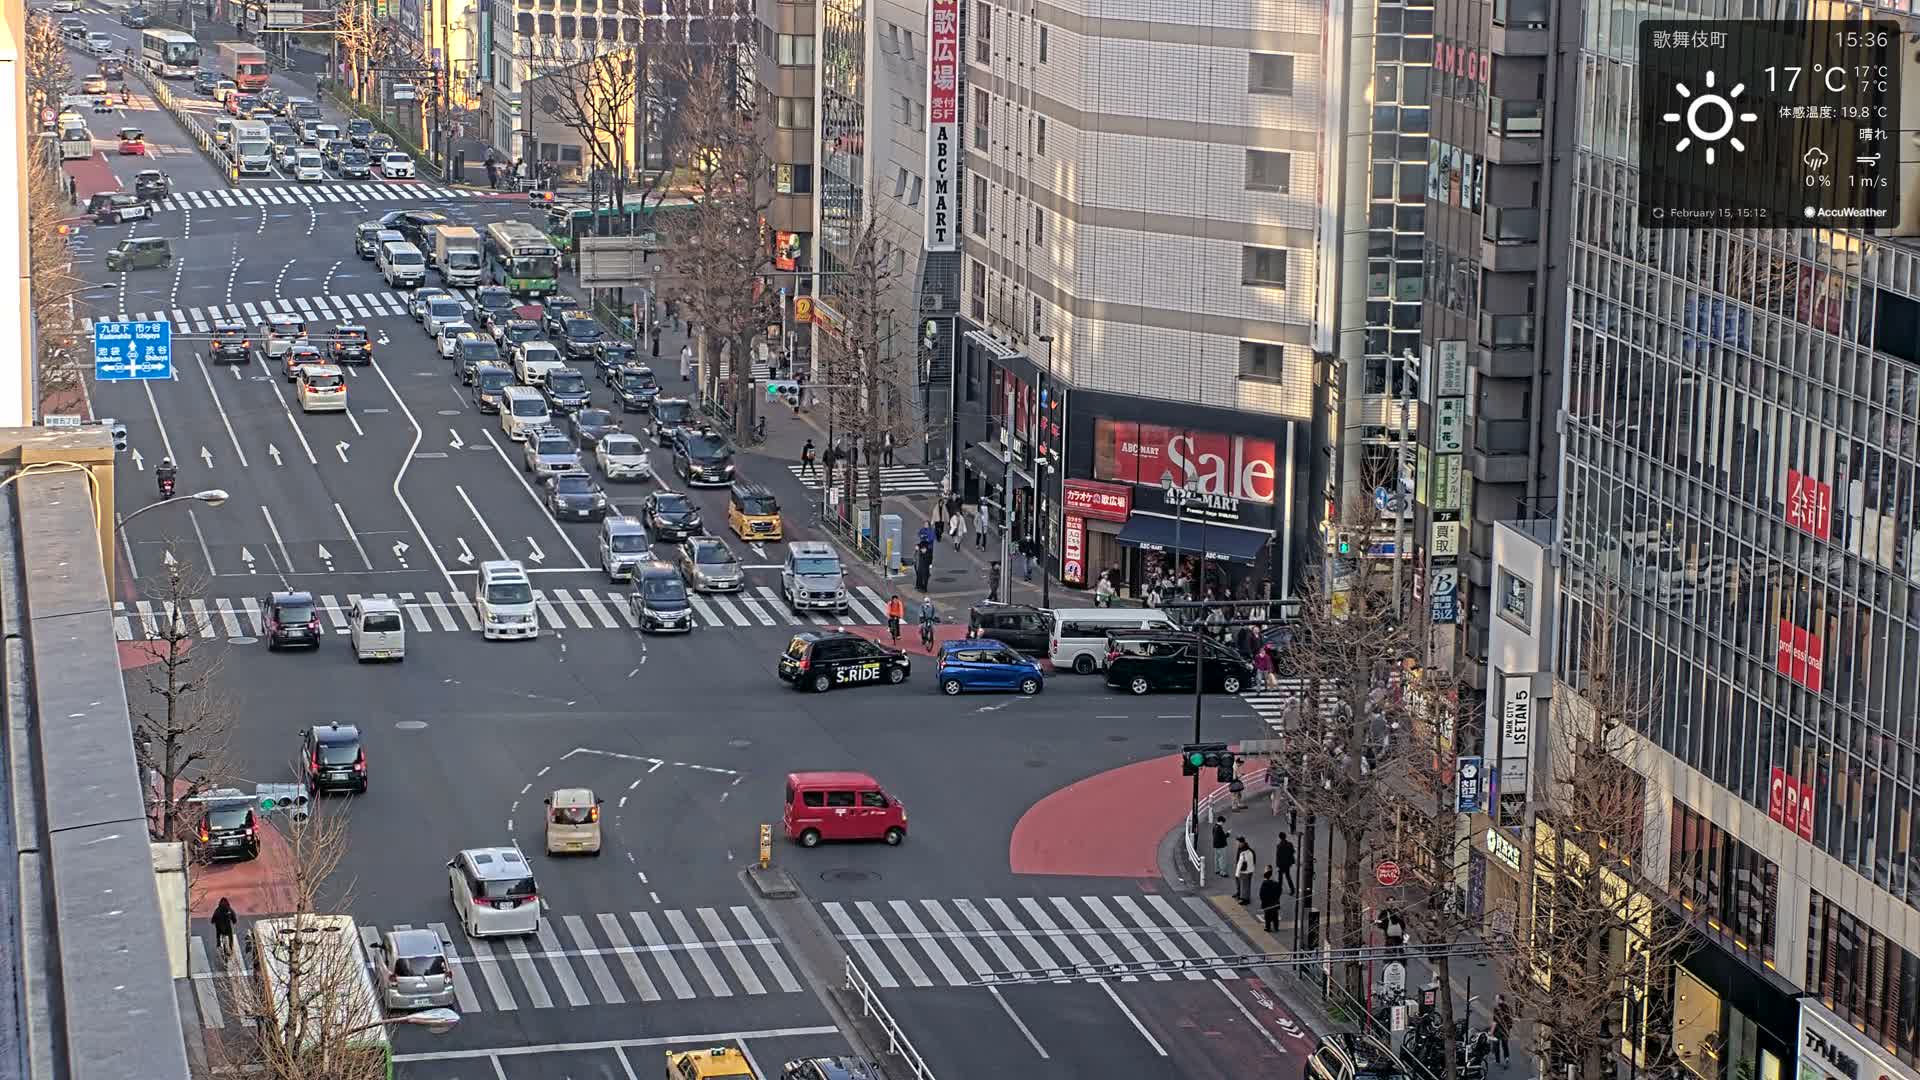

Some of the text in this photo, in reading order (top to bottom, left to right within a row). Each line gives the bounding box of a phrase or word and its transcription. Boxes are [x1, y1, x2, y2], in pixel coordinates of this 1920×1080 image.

[933, 8, 955, 91] 歌広場
[1434, 42, 1488, 83] AMIGO
[932, 109, 954, 119] 5F
[935, 126, 948, 242] ABC-MART
[101, 323, 130, 333] 九段下
[1167, 434, 1275, 504] Sale
[1066, 489, 1093, 503] カラオケ
[1101, 494, 1126, 508] 歌広場
[1440, 513, 1452, 521] 7F
[1791, 480, 1828, 530] 会計
[1436, 525, 1449, 553] 買取
[836, 667, 880, 683] S.RIDE
[1505, 701, 1516, 738] PARK CITY
[1514, 690, 1528, 745] ISETAN 5
[1772, 778, 1812, 827] CPA
